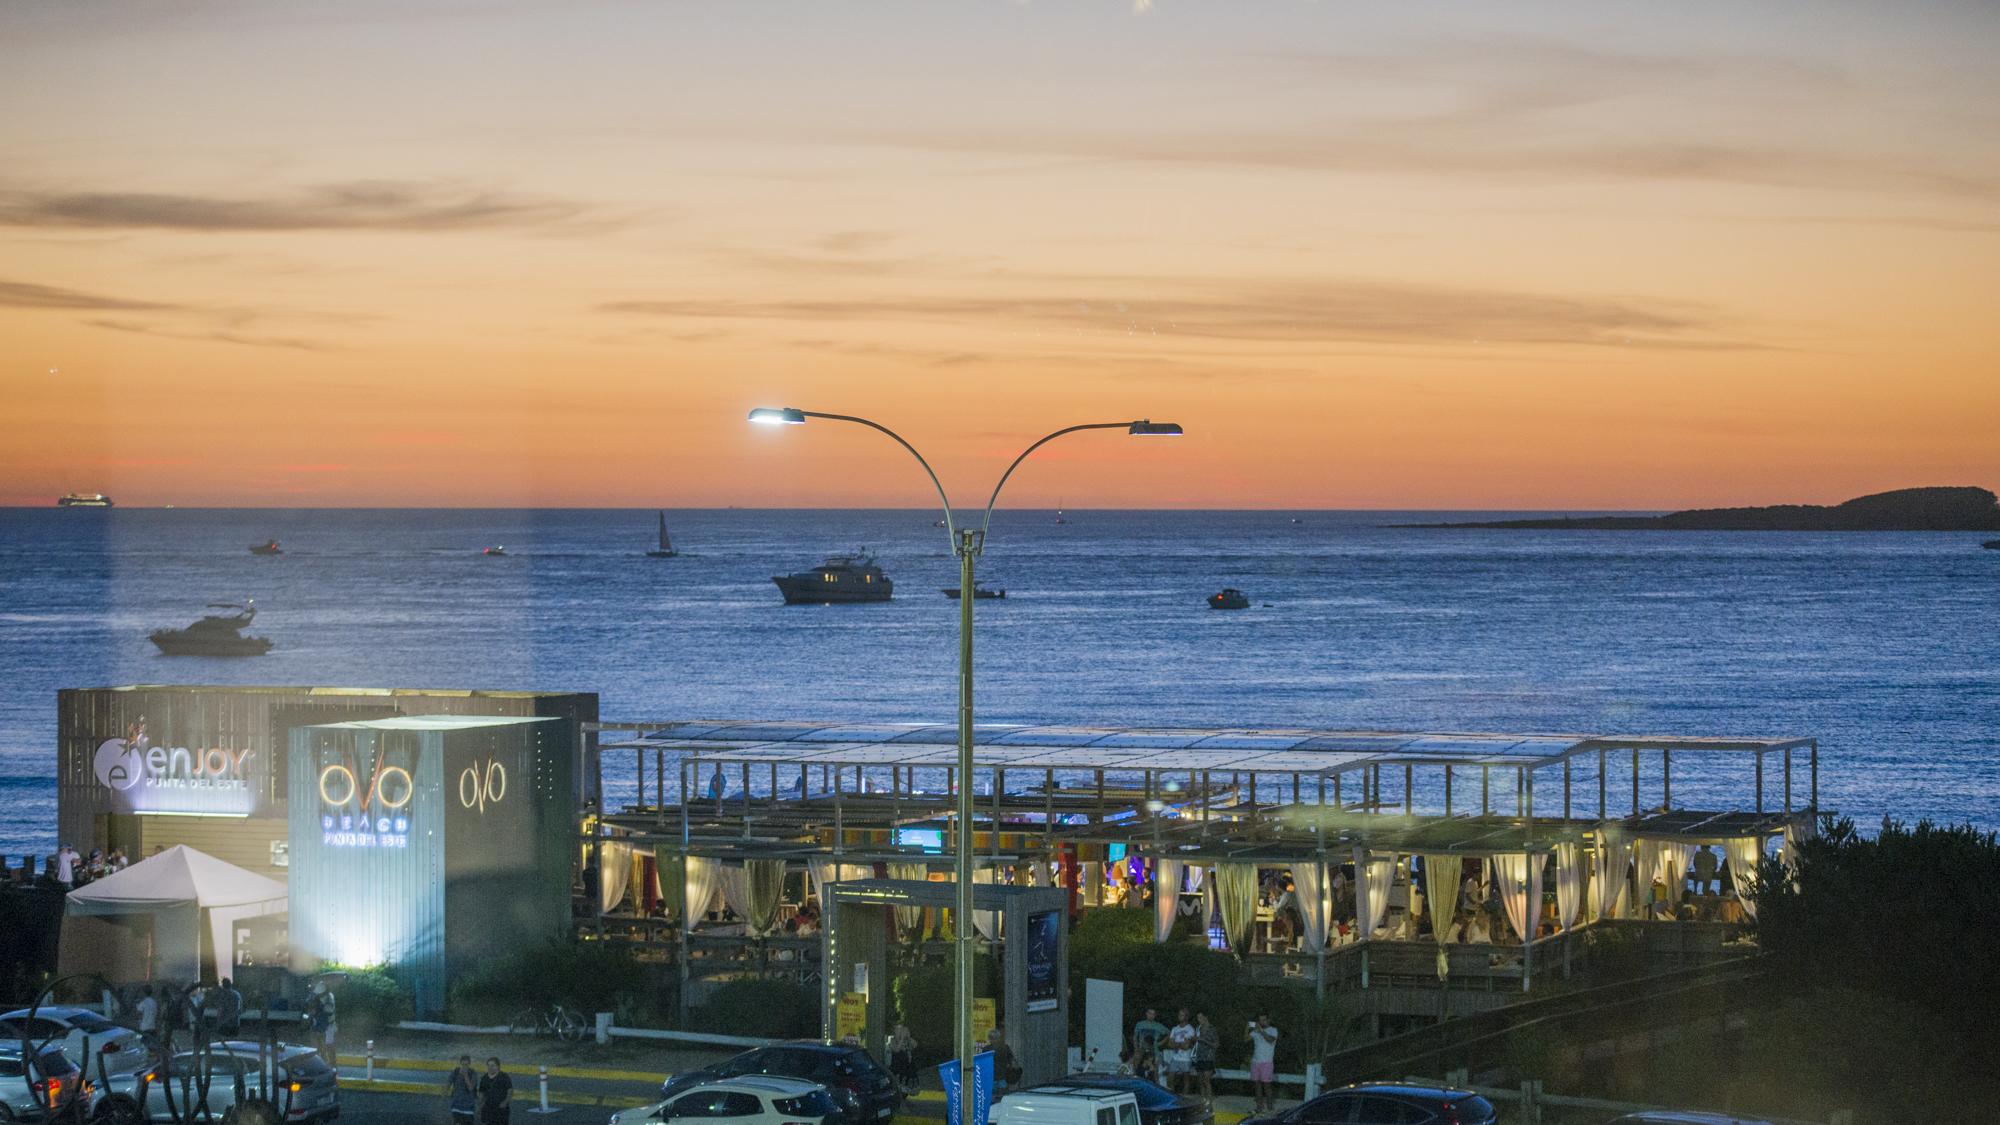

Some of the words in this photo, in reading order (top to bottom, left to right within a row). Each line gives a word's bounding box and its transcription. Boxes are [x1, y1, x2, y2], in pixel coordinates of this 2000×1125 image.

[145, 778, 187, 789] PUNTA
[189, 779, 212, 789] DEL
[218, 779, 248, 790] ESTE
[319, 752, 413, 810] OVO
[459, 758, 506, 815] OVO
[322, 815, 409, 831] BEACH
